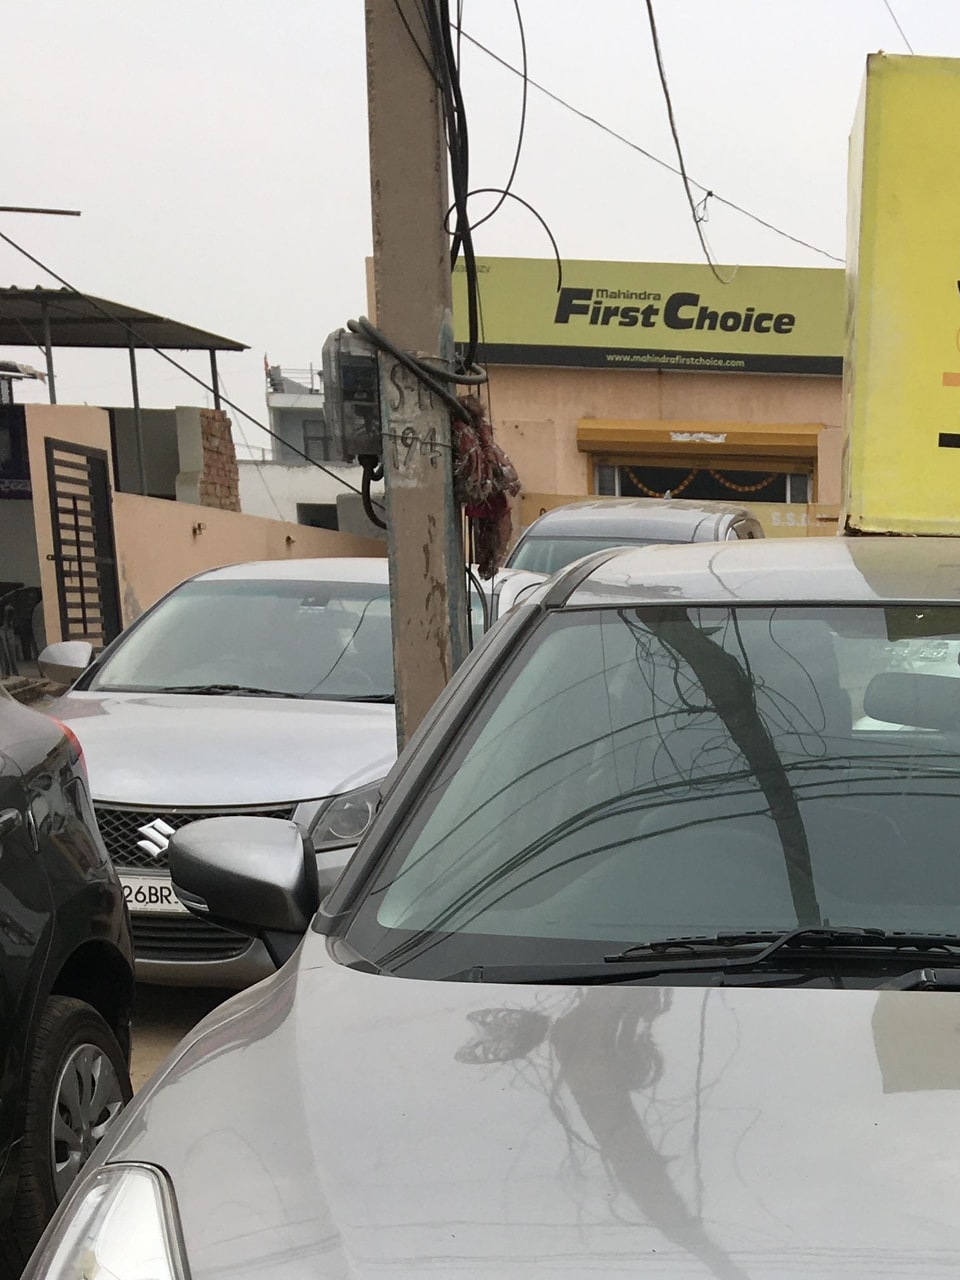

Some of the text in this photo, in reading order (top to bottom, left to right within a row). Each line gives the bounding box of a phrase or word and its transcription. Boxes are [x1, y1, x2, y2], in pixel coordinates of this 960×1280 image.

[596, 288, 661, 301] Mahindra
[554, 287, 795, 335] First Choice
[606, 353, 745, 368] www.mahindrafirstchoice.com
